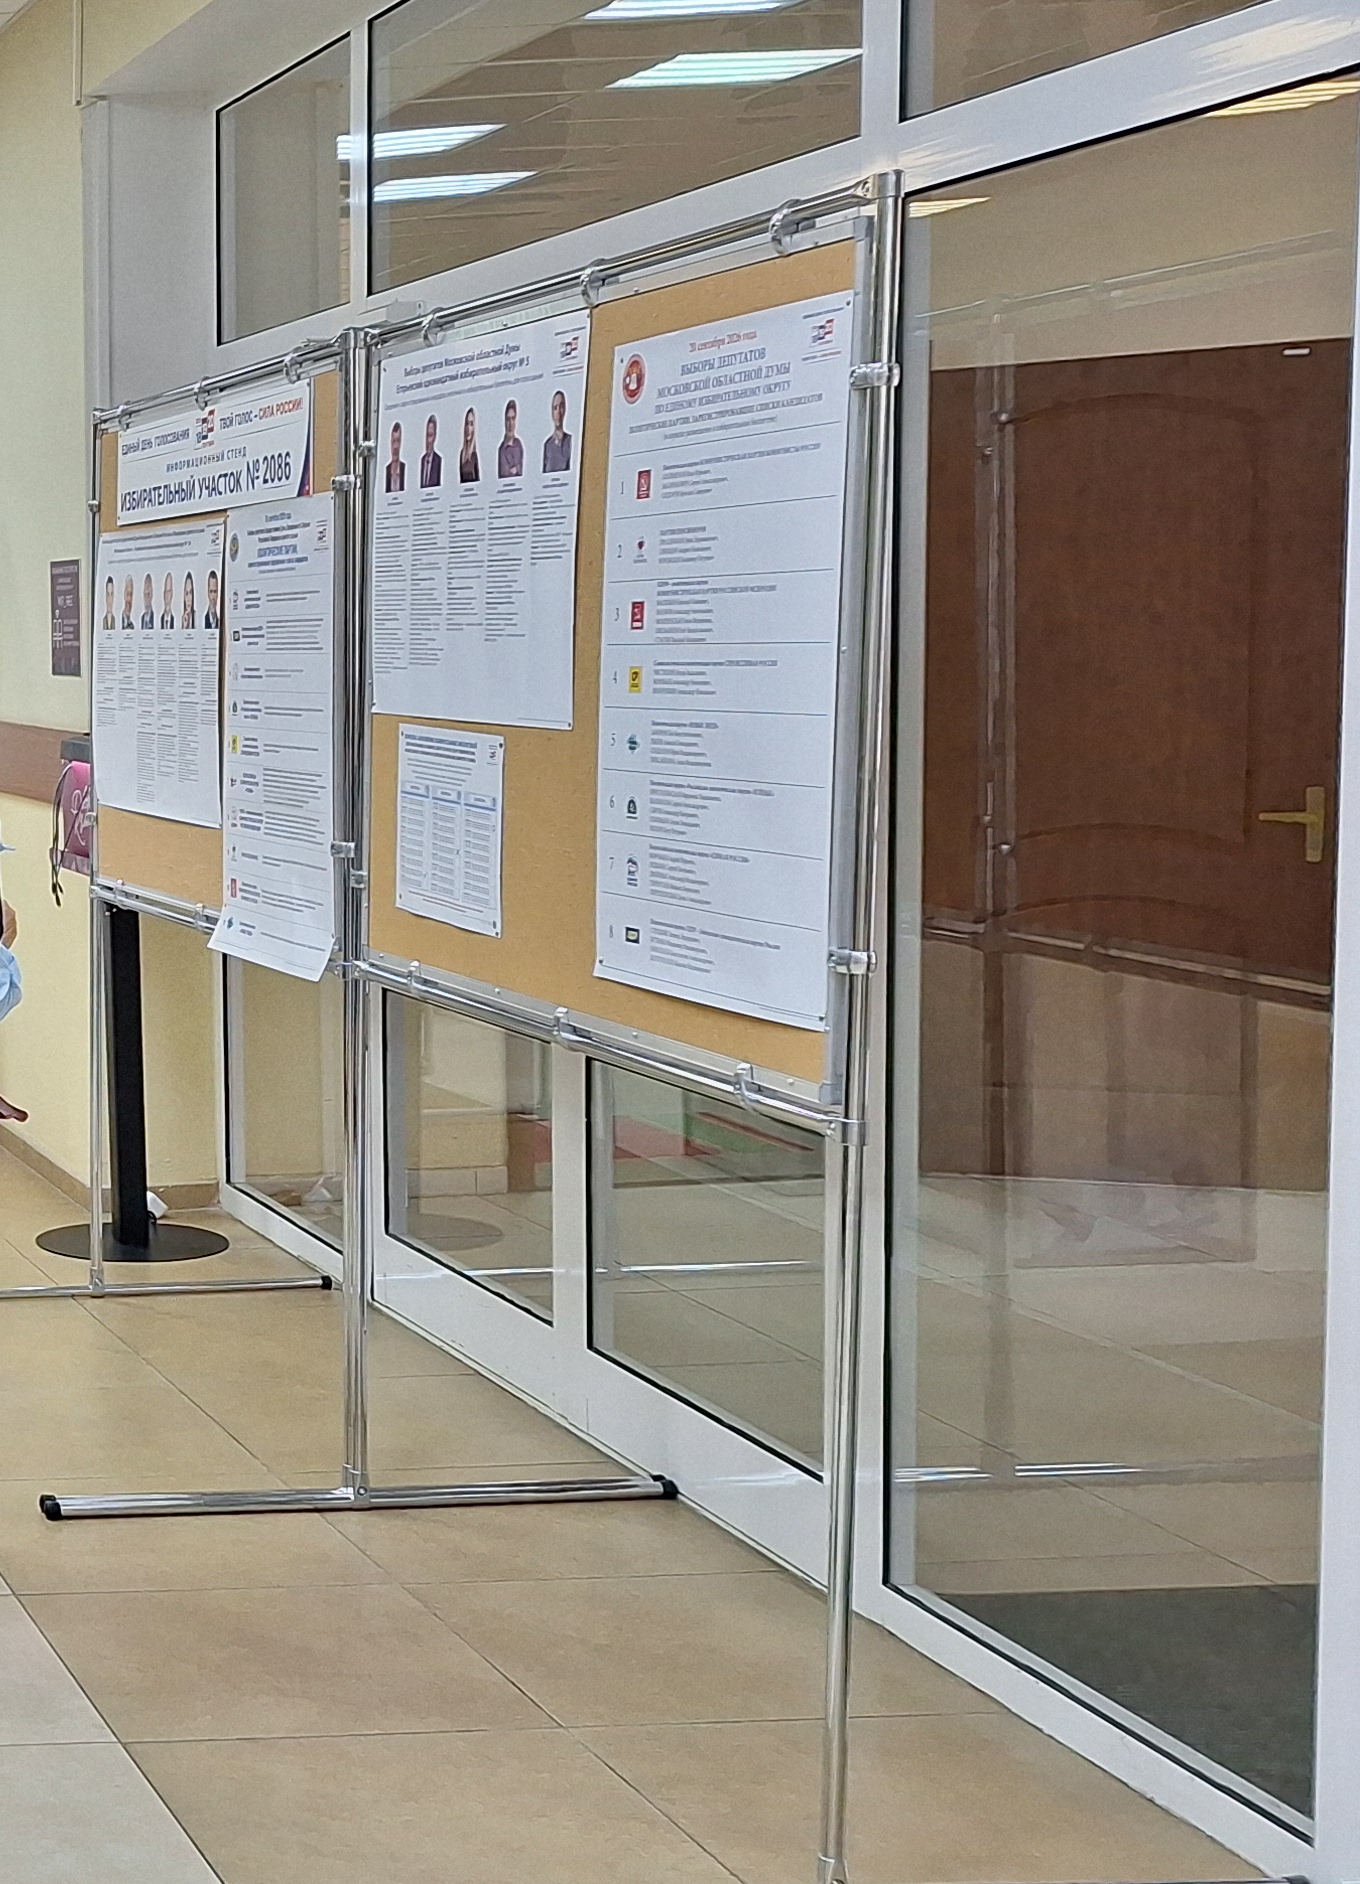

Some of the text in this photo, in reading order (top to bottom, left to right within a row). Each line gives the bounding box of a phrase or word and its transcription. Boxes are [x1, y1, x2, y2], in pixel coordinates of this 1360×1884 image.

[680, 347, 766, 376] ВЫБОРЫ ДЕПУТАТОВ
[656, 361, 791, 399] МОСКОВСКОЙ ОБЛАСТНОЙ ДУМЫ
[219, 414, 234, 430] ТВОЙ
[234, 410, 253, 426] ГОЛОС
[258, 404, 275, 421] СИЛА
[276, 397, 304, 416] РОССИИ!
[121, 428, 190, 456] ЕДИНЫЙ ДЕНЬ ГОЛОСОВАНИЯ
[166, 446, 247, 473] ИНФОРМАЦИОННЫЙ СТЕНД
[120, 450, 292, 513] ИЗБИРАТЕЛЬНЫЙ УЧАСТОК № 2086
